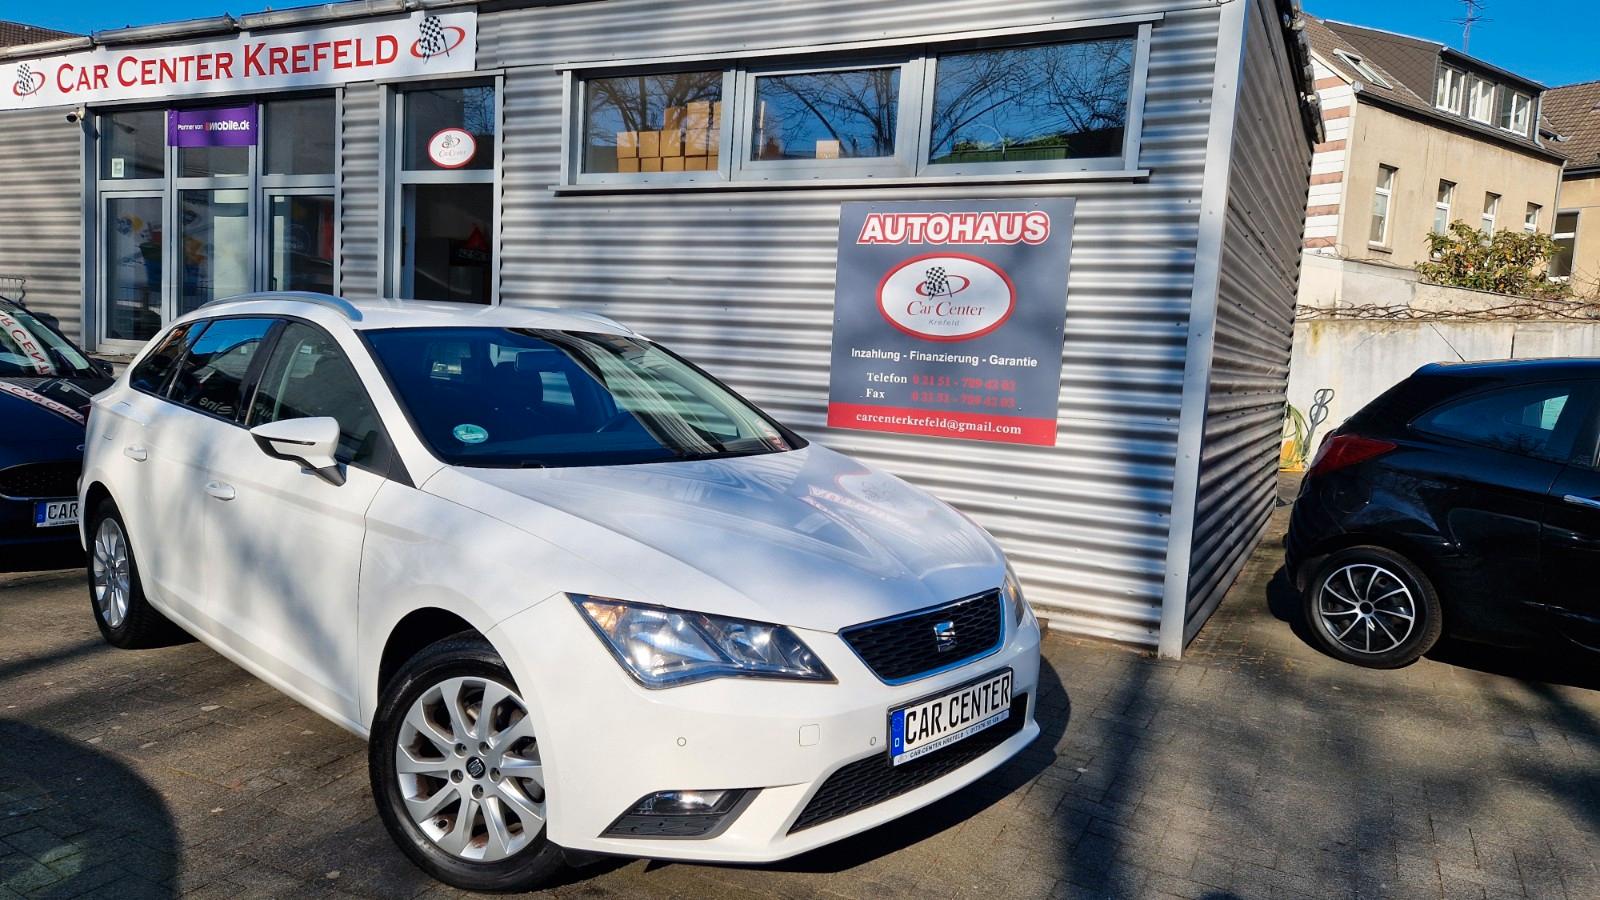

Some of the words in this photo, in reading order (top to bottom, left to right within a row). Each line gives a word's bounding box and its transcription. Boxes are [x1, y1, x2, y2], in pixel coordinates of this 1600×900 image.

[56, 63, 109, 93] CAR
[117, 52, 234, 87] CENTER
[243, 34, 399, 77] KREFELD
[857, 211, 1051, 245] AUTOHAUS
[907, 300, 934, 316] Car
[935, 301, 985, 316] Center
[928, 319, 960, 327] Krefeld
[851, 348, 901, 362] Inzahlung
[909, 350, 979, 366] Finanzierung
[989, 355, 1038, 368] Garantie
[866, 372, 908, 384] Telefon
[865, 388, 885, 399] Fax
[856, 412, 1022, 435] carcenterkrefeld@gmail.com
[48, 502, 78, 520] CAR
